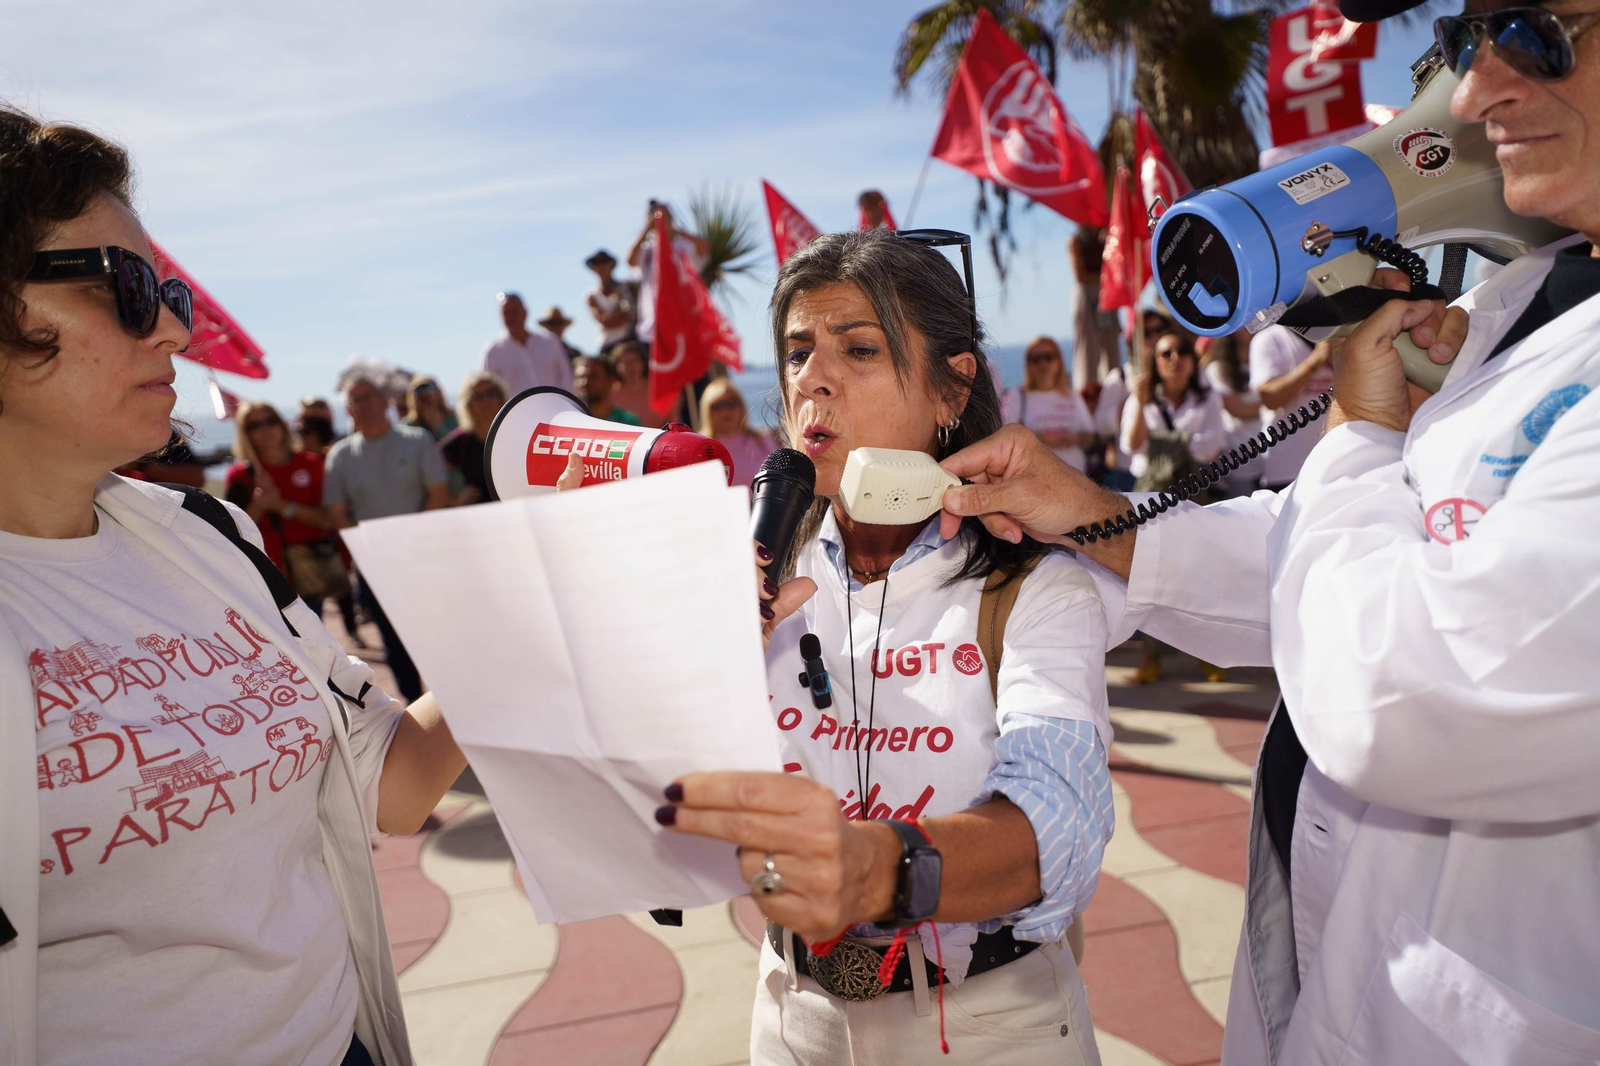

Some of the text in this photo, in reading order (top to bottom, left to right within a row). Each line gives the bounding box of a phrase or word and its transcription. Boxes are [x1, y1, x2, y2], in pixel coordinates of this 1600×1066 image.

[1419, 146, 1444, 165] CGT
[1280, 164, 1333, 188] VONYX
[1160, 216, 1191, 266] MEGAPHONE
[1198, 233, 1214, 255] HI-POWER
[583, 461, 623, 480] evilla
[870, 643, 945, 679] UGT
[771, 699, 954, 753] o Primero
[51, 780, 236, 876] PARA
